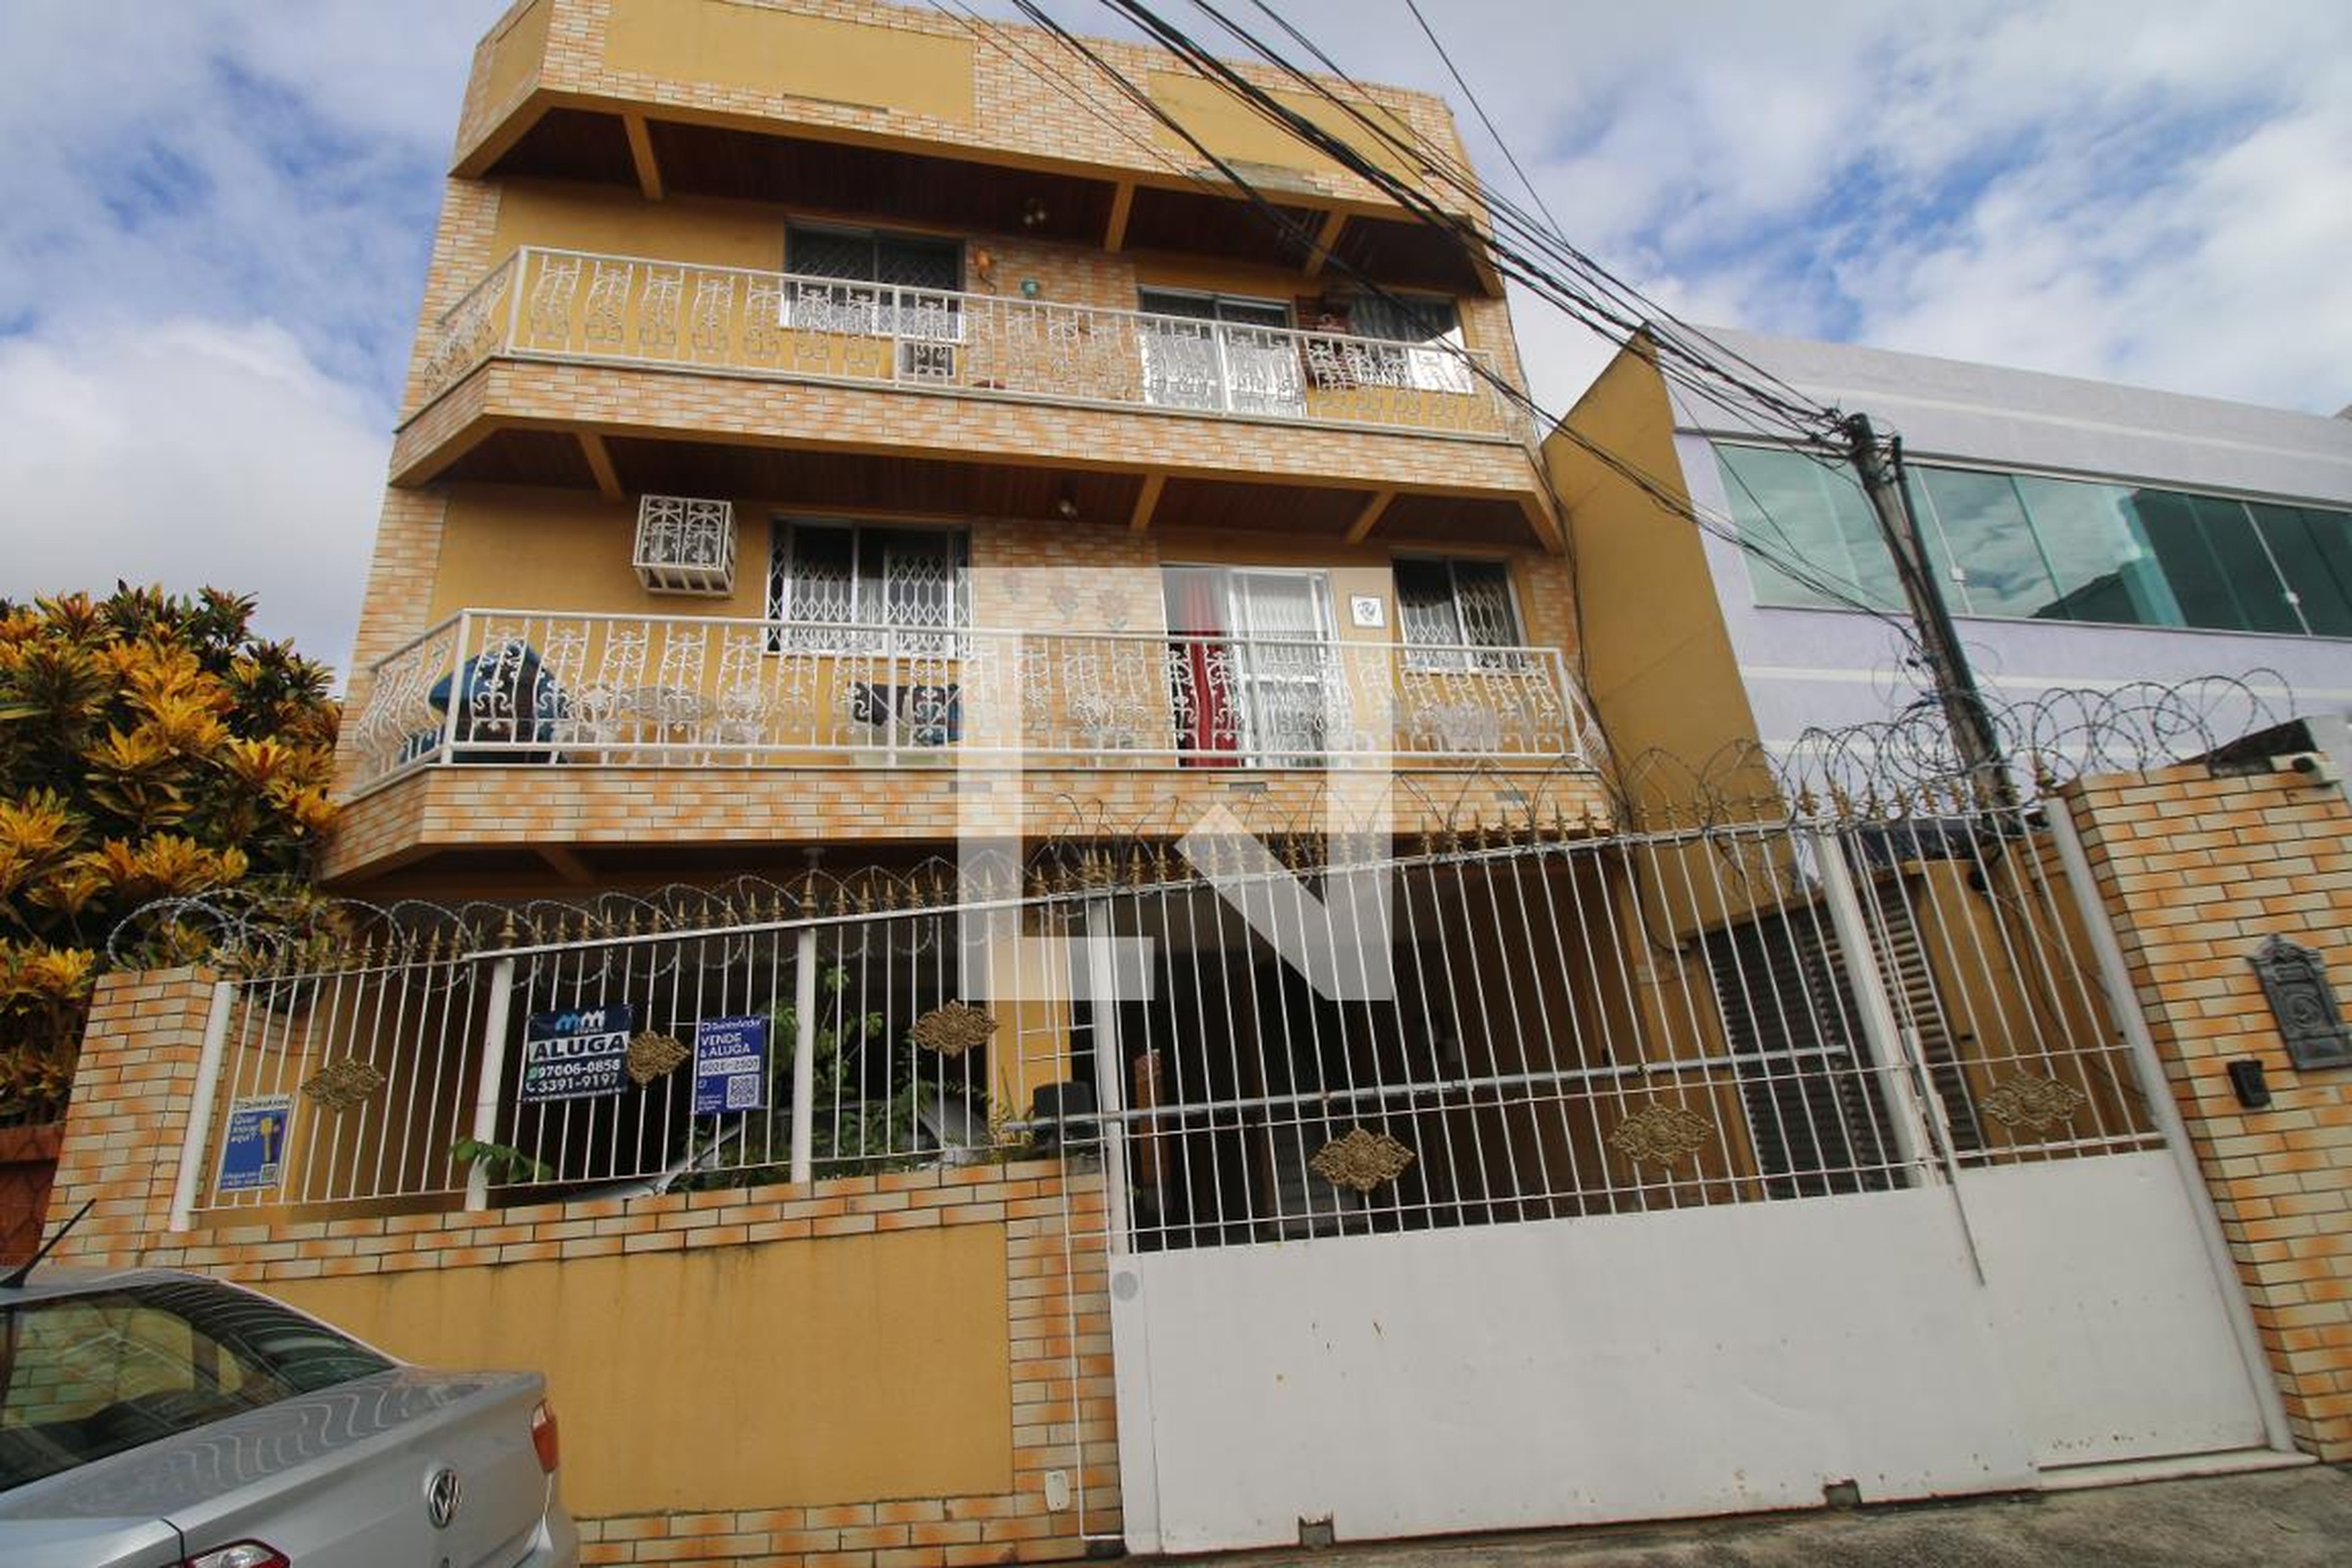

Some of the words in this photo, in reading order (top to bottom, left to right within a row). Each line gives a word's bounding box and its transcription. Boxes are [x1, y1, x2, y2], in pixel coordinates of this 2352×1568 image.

[534, 1035, 625, 1060] ALUGA
[701, 1033, 742, 1046] VENDE
[709, 1043, 750, 1057] ALUGA
[538, 1072, 618, 1093] 3391-9197
